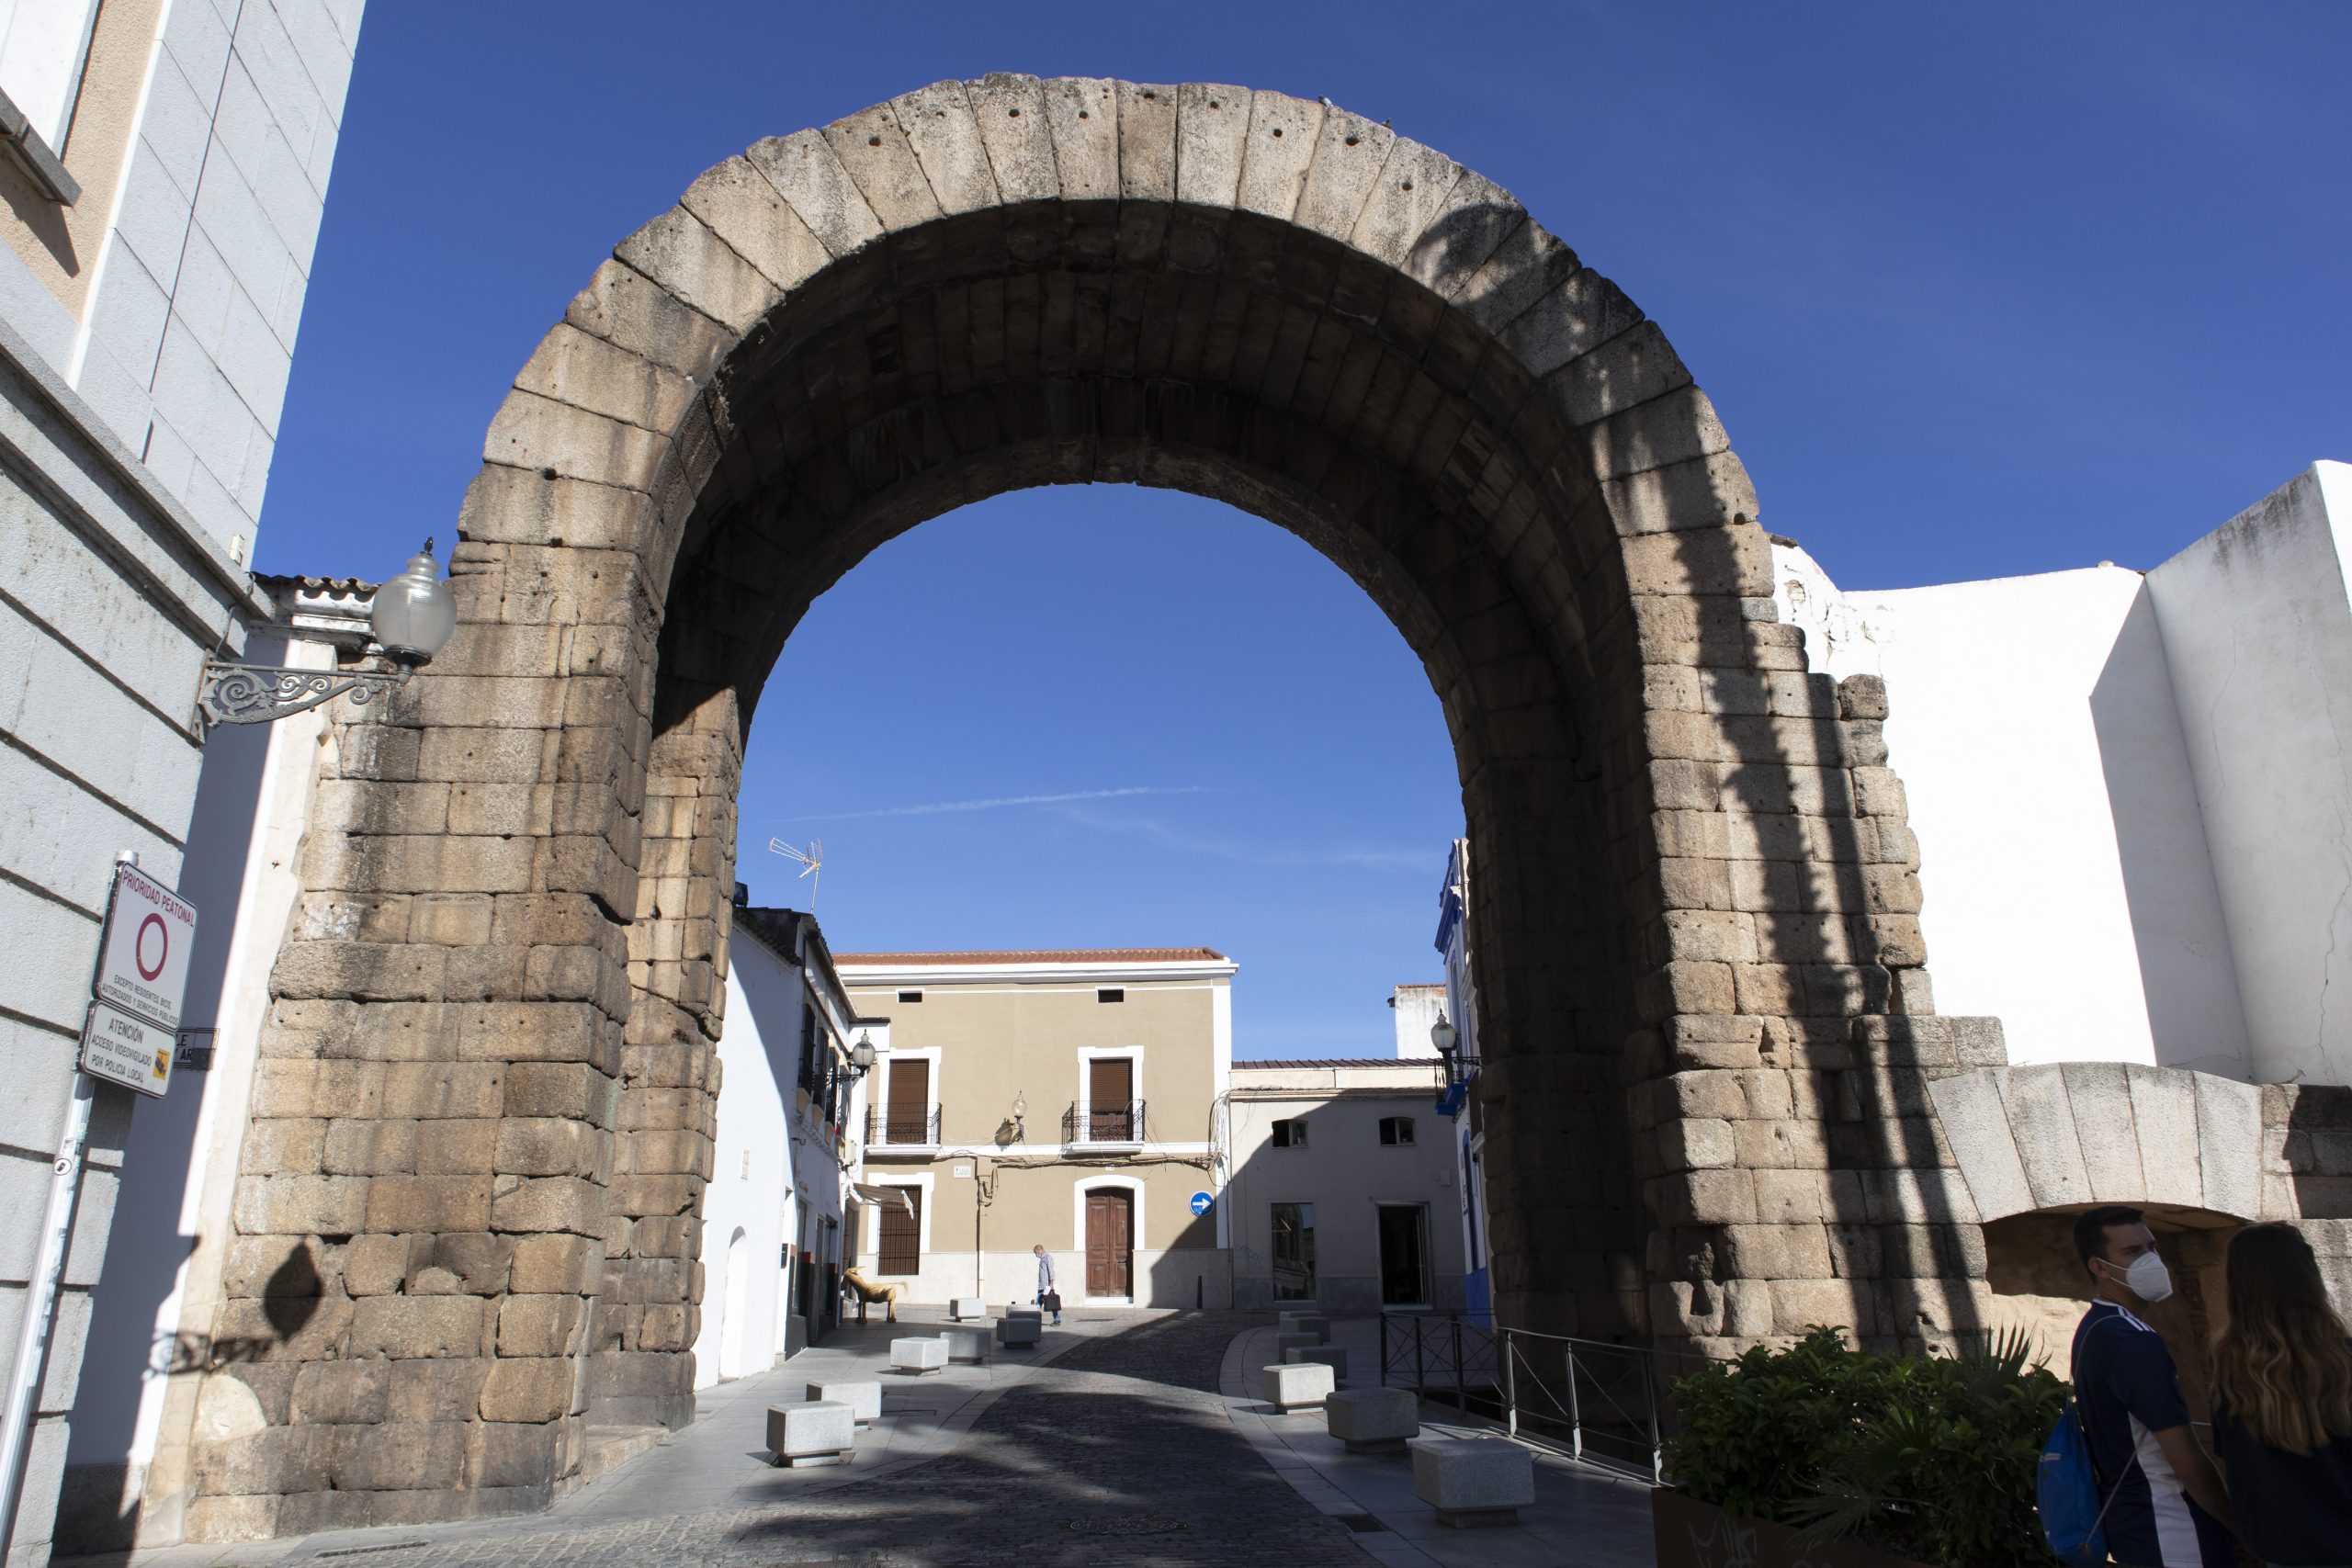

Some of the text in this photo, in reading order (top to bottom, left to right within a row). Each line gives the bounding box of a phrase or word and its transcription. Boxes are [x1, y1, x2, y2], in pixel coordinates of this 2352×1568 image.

[122, 870, 194, 927] PRIORIDAD PEATONAL
[114, 975, 134, 991] EXCEPTO
[102, 983, 132, 1004] AUTORIZADOS
[137, 999, 158, 1016] SERVICIOS
[108, 1017, 144, 1044] ATENCIÓN
[91, 1033, 152, 1066] ACCESO VIDEOVIGILADO
[92, 1054, 104, 1067] POR
[127, 1067, 143, 1083] LOCAL
